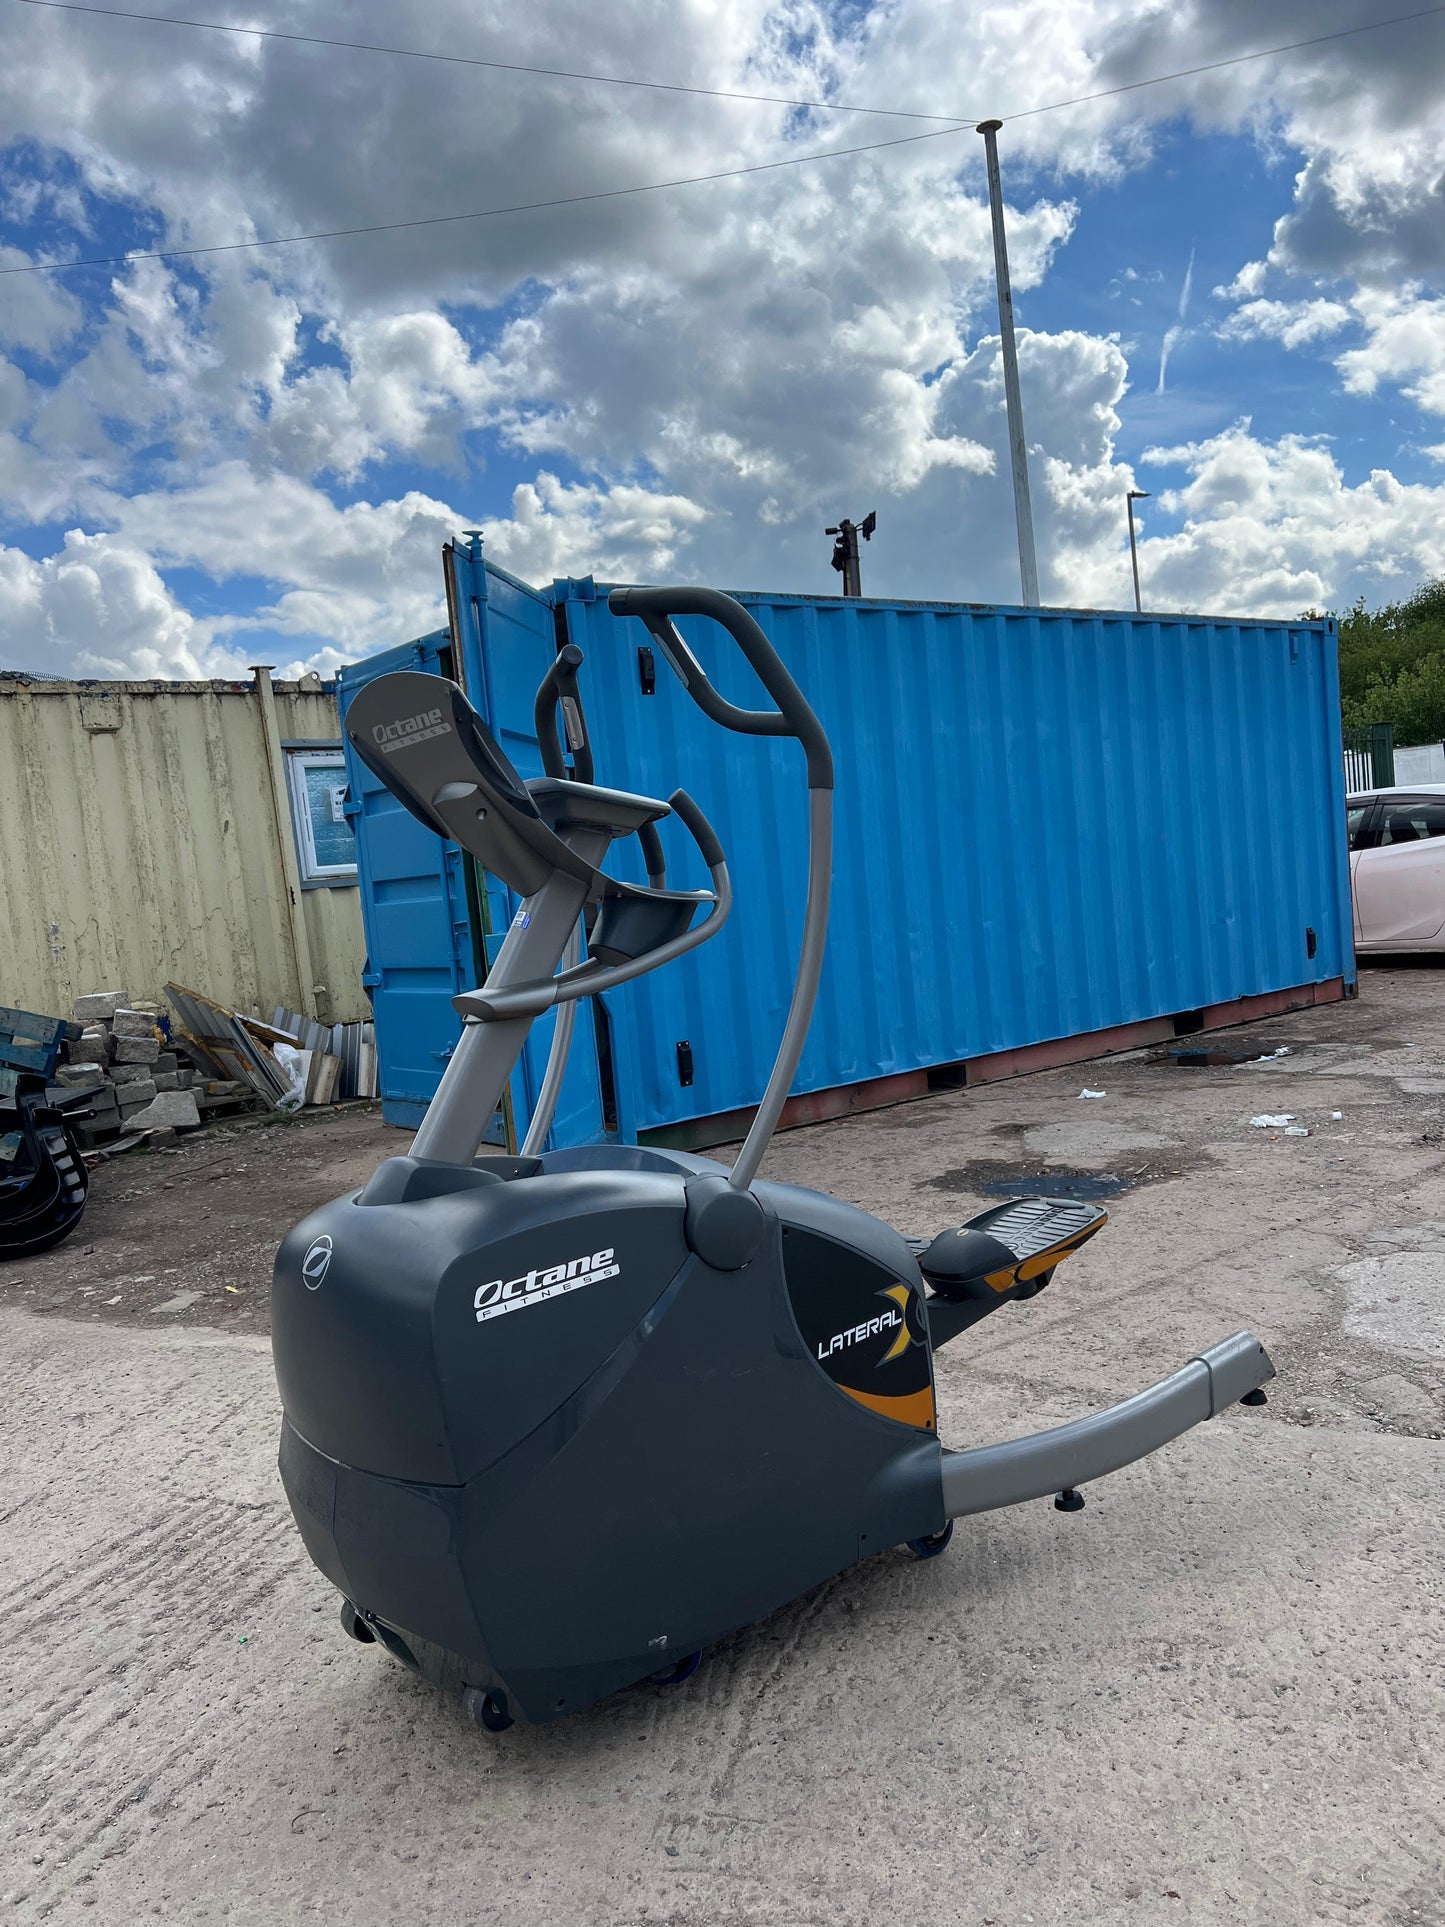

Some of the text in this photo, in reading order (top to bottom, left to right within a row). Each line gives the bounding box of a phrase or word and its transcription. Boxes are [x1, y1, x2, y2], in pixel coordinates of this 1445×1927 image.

[372, 708, 442, 743] Octane
[381, 723, 451, 753] FITNESS
[474, 1248, 615, 1309] Octane
[481, 1267, 614, 1319] FITNESS
[818, 1309, 902, 1360] LATERAL
